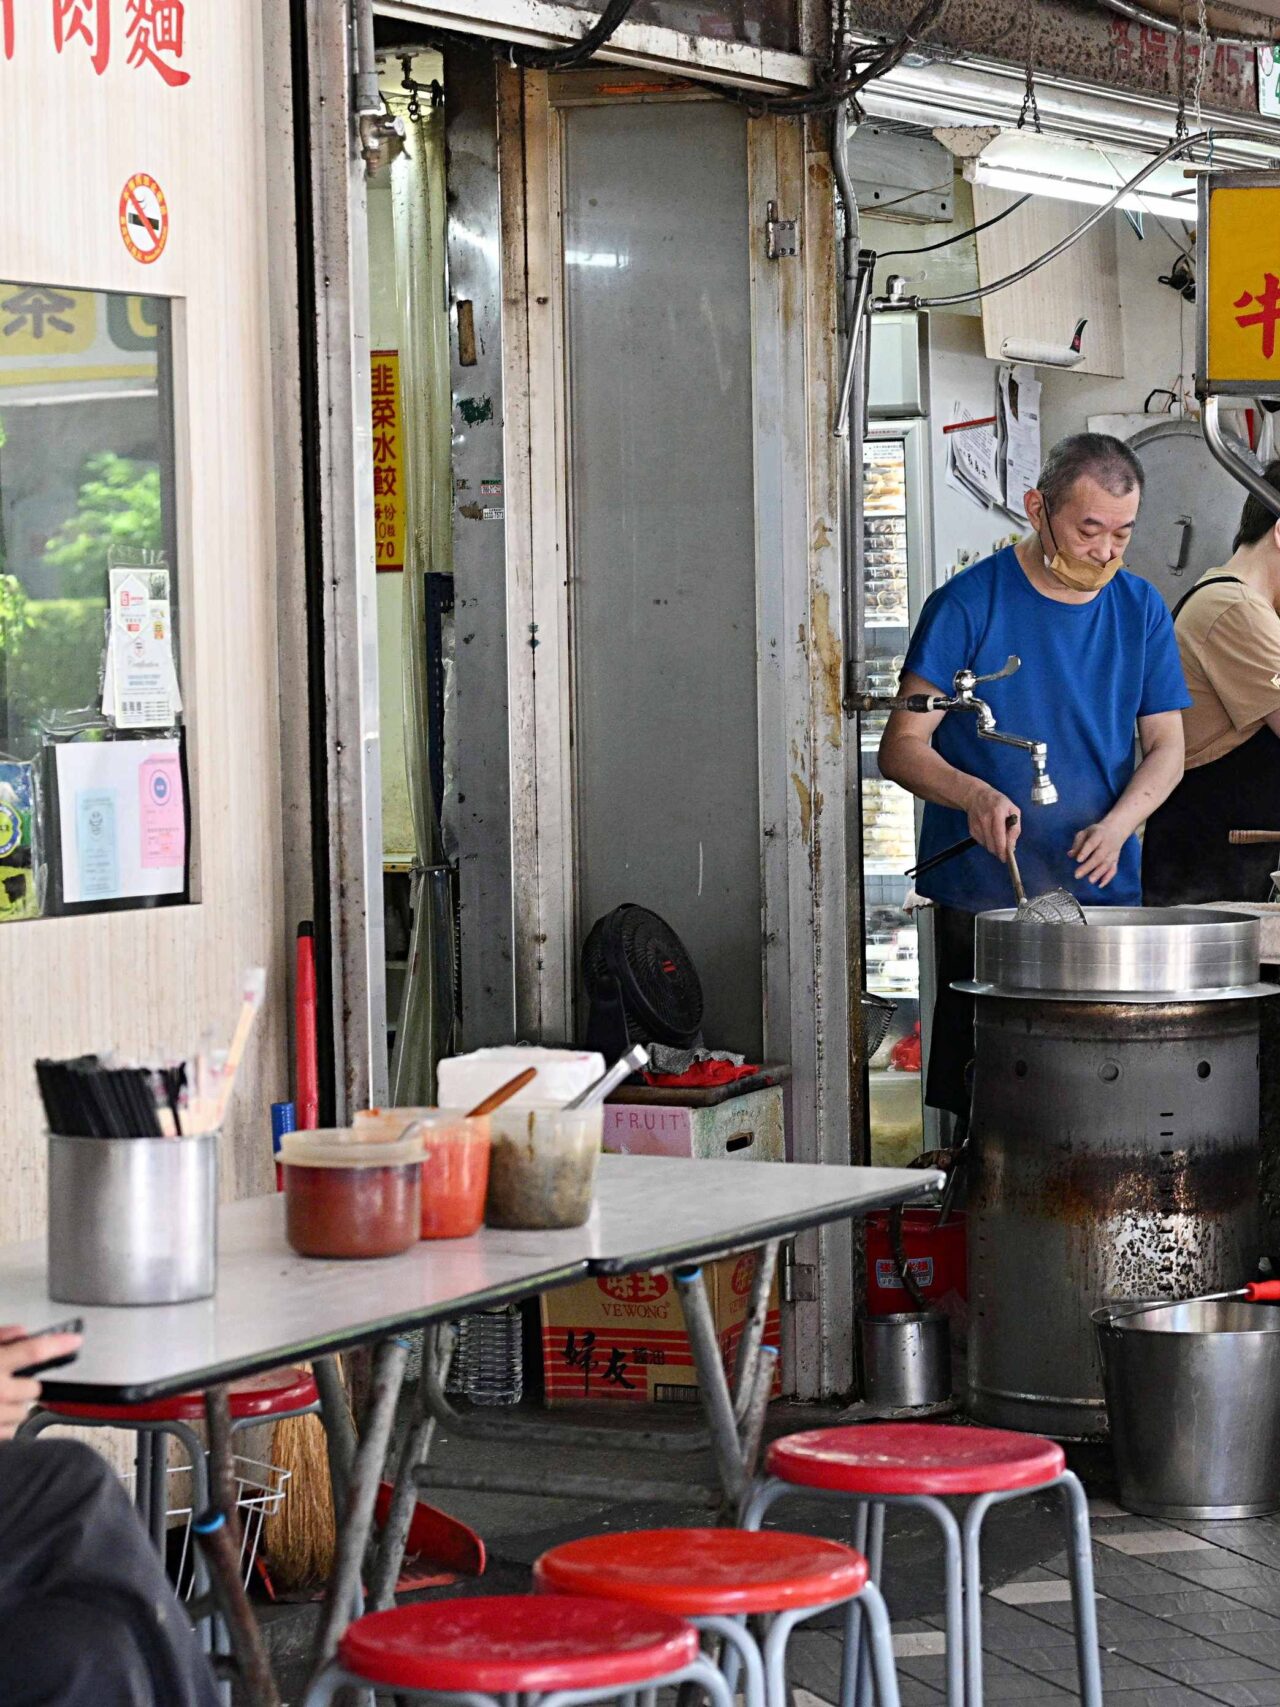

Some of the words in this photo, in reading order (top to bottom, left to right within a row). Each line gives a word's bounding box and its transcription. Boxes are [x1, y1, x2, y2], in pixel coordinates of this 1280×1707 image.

[1, 0, 191, 87] 肉麵
[371, 364, 396, 497] 韭菜水餃
[602, 1303, 668, 1320] VEWONG
